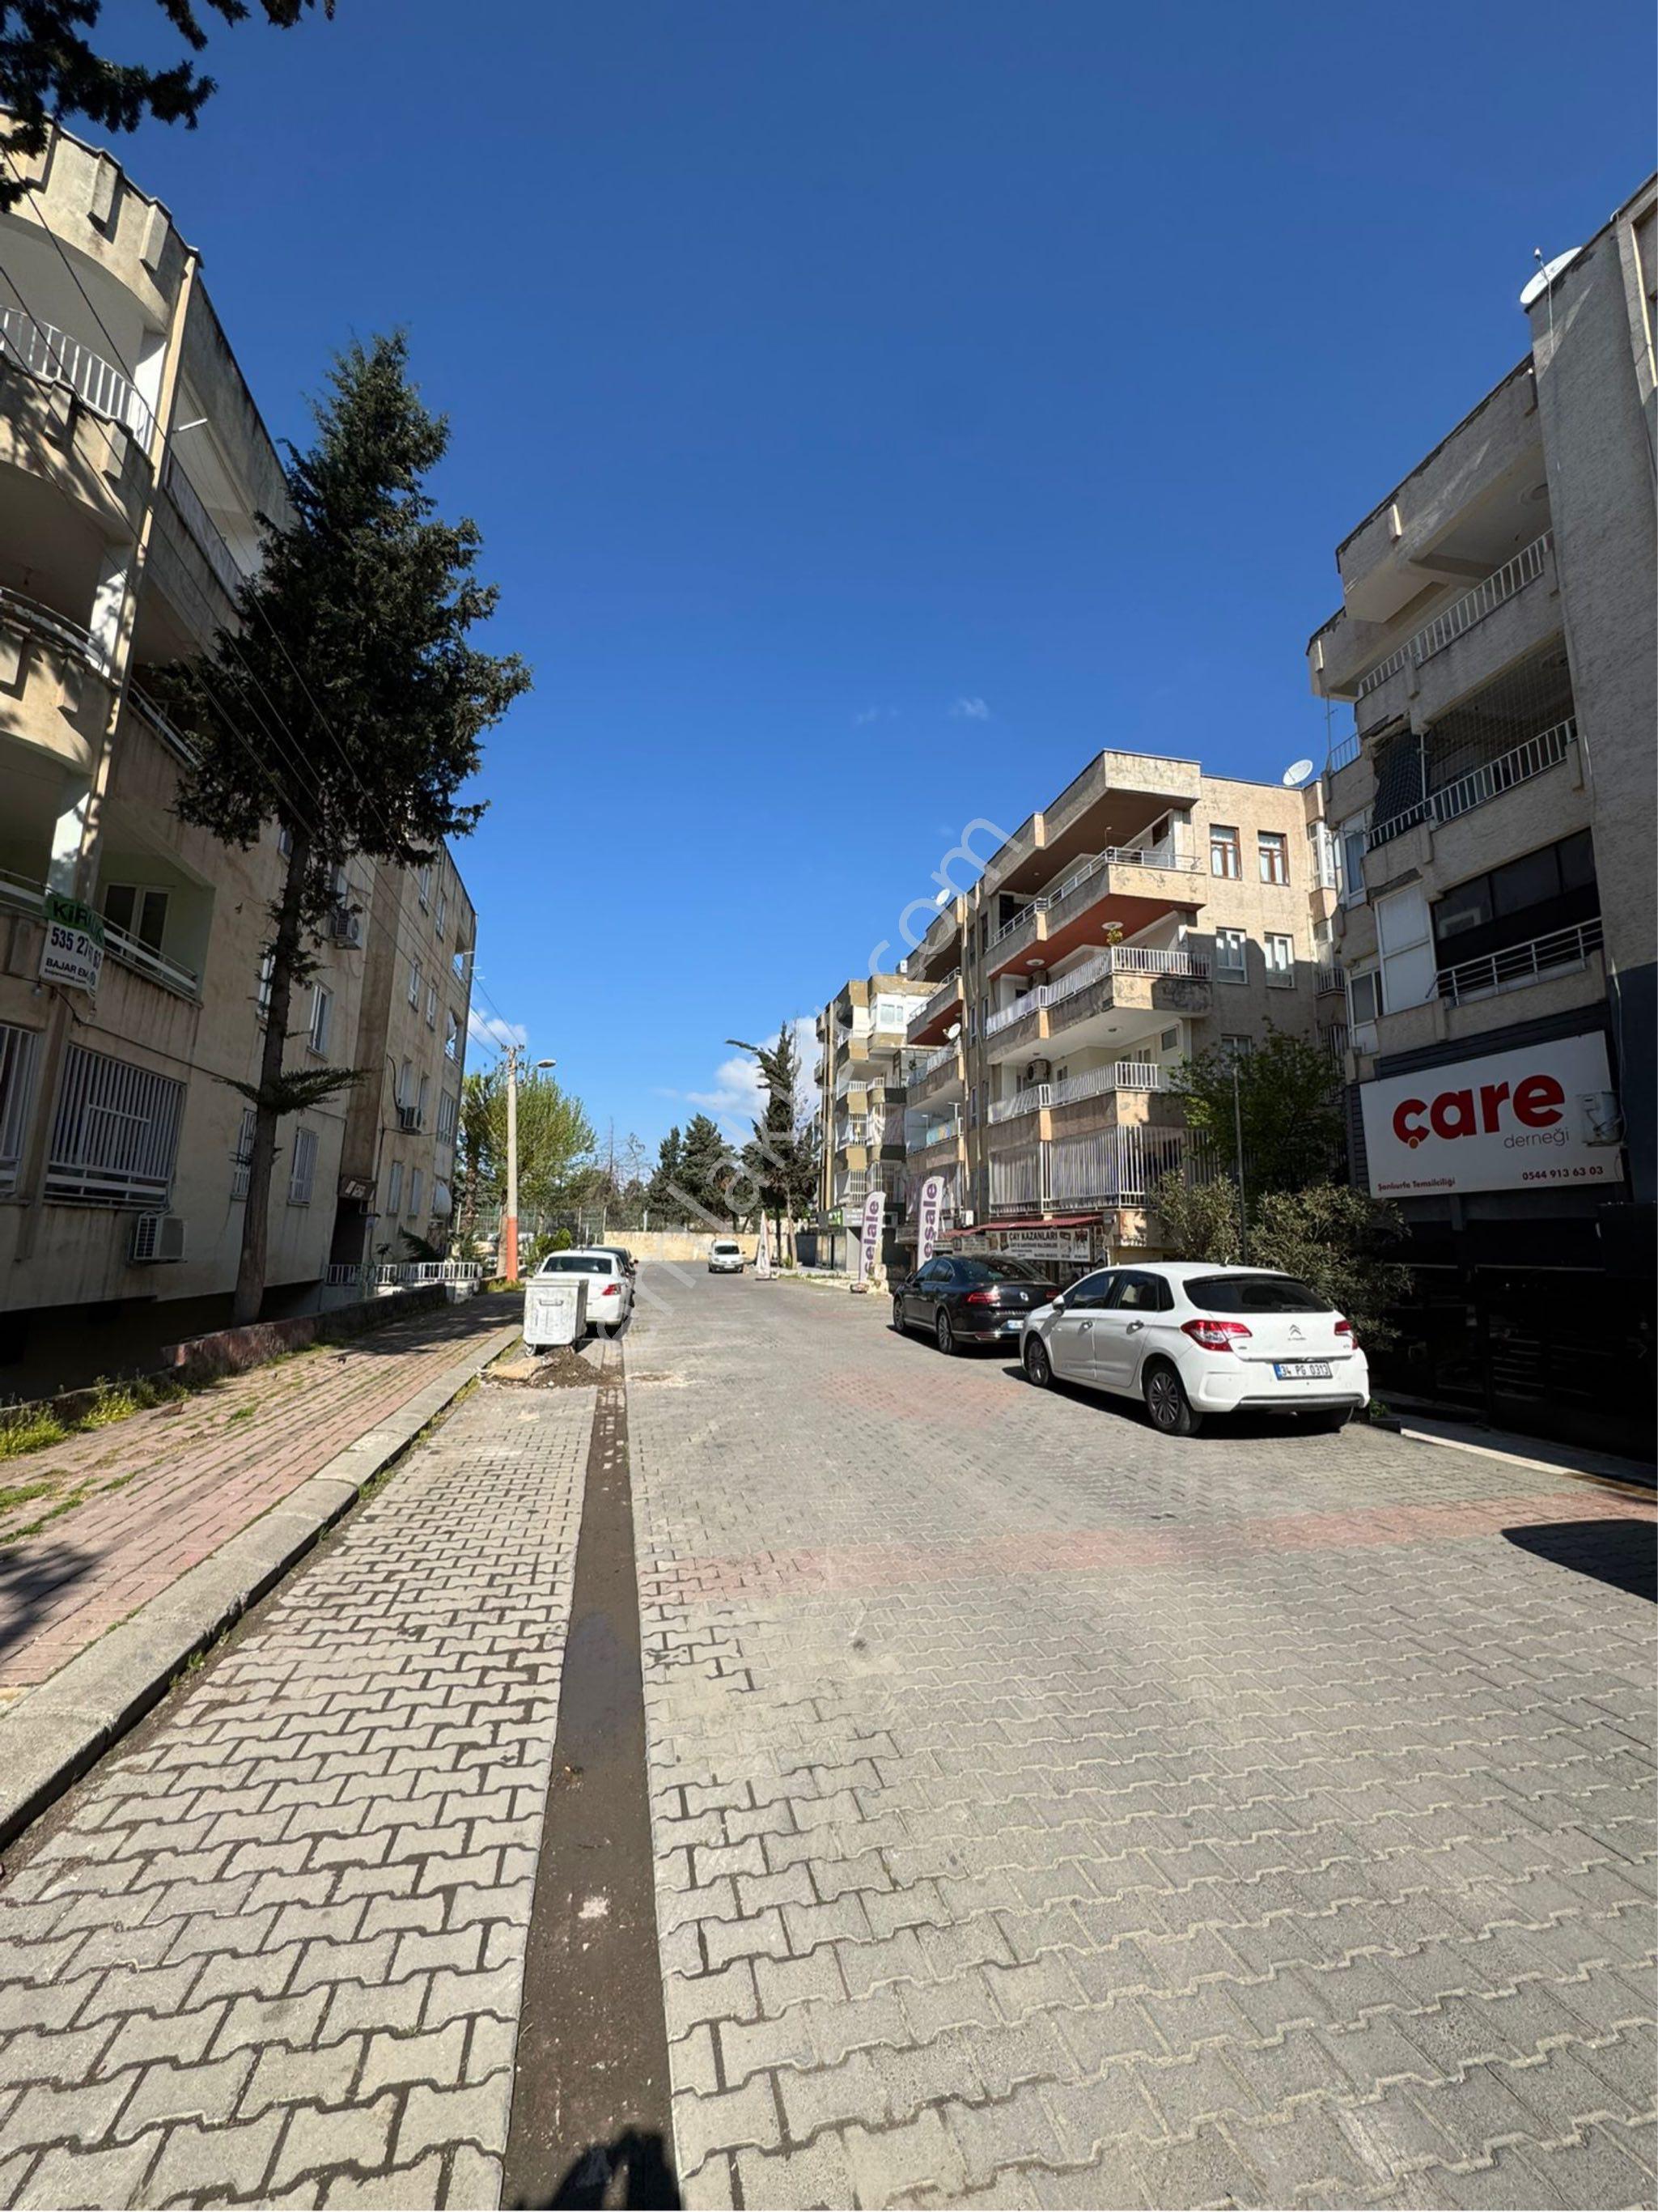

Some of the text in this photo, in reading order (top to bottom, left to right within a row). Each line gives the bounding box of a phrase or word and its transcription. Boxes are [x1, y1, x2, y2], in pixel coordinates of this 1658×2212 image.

[51, 927, 74, 951] 535
[46, 957, 77, 974] BAJAR
[1393, 1074, 1566, 1149] çare
[1503, 1127, 1569, 1149] derneği
[1522, 1165, 1604, 1181] 0544 913 63 03
[1412, 1176, 1456, 1189] Temsilciliği
[1281, 1365, 1291, 1377] 34
[1309, 1365, 1329, 1376] 0313
